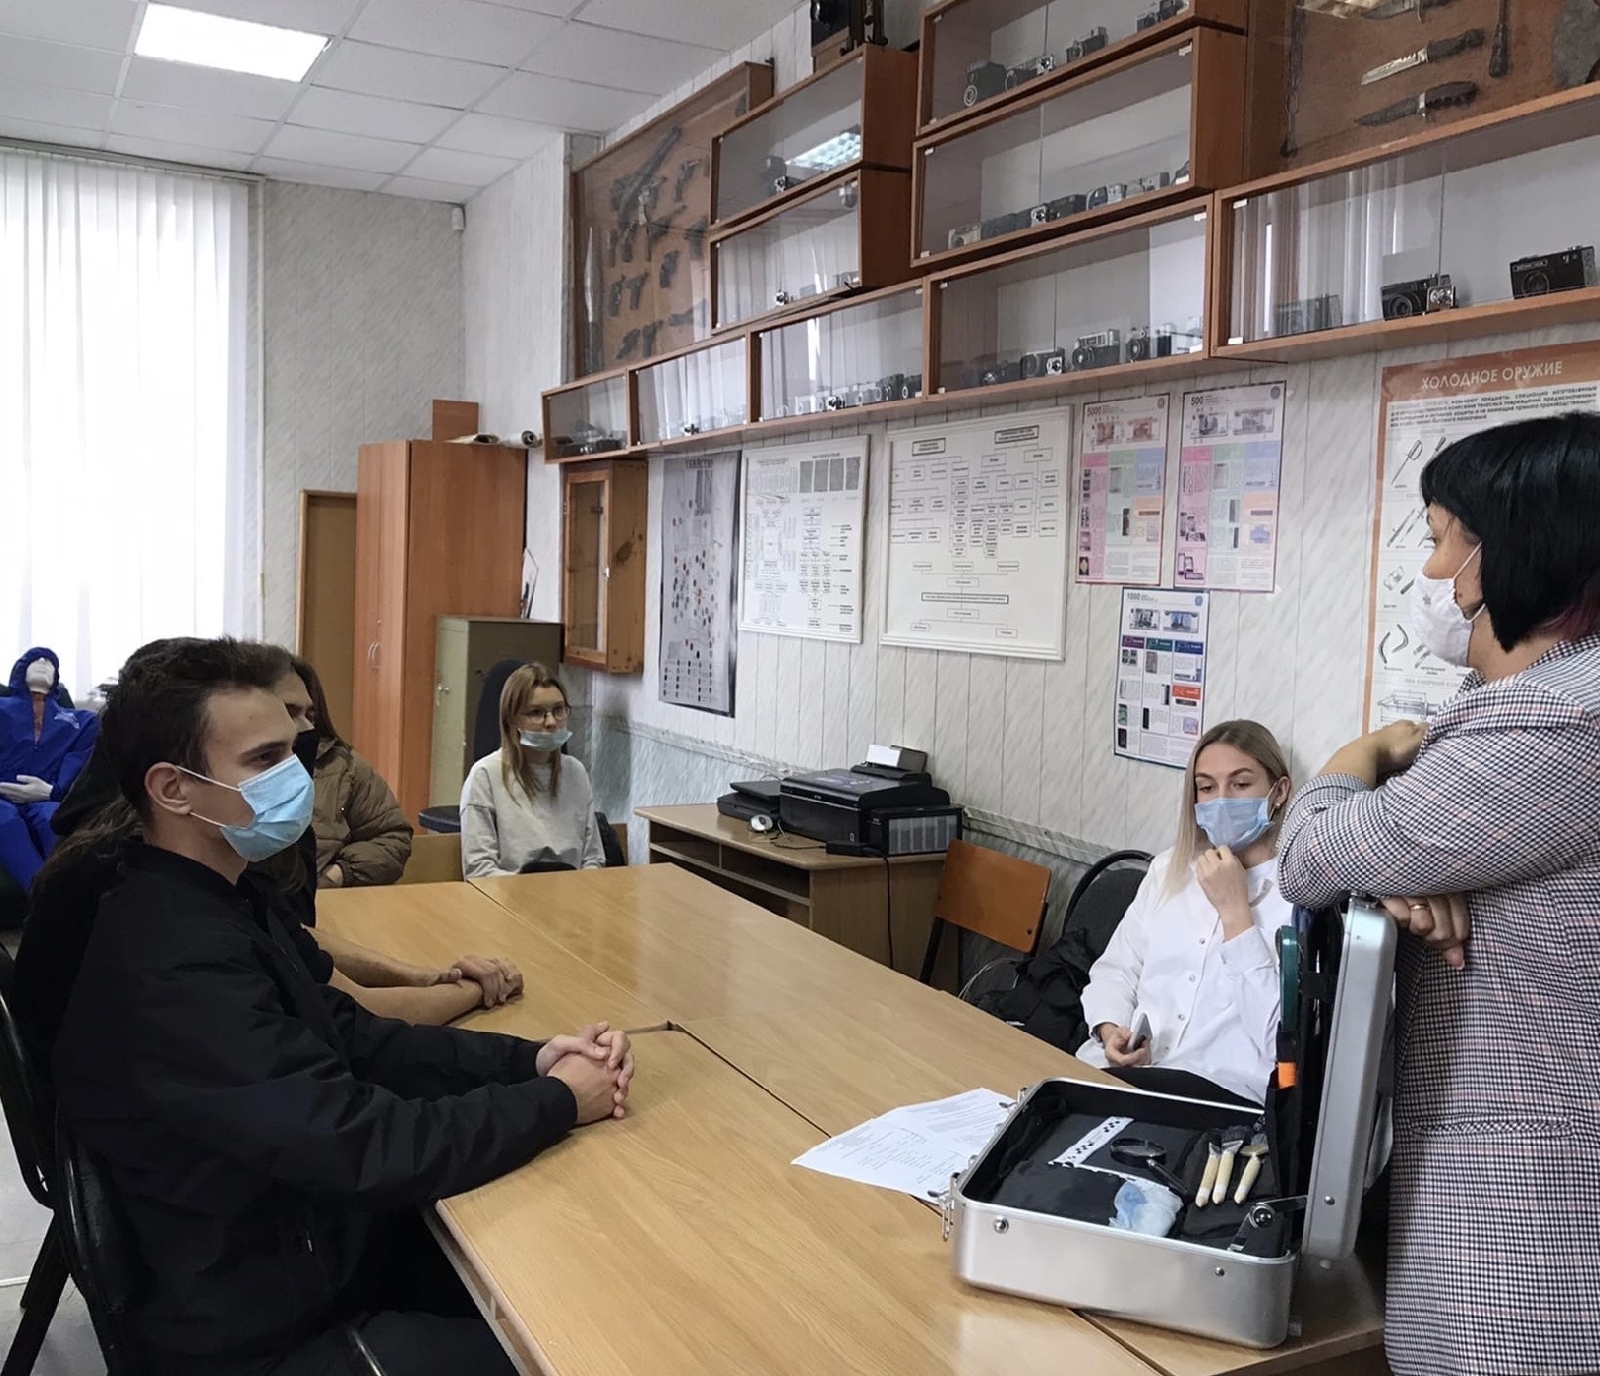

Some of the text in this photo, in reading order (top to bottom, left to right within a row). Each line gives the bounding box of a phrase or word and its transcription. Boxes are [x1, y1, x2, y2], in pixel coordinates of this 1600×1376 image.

[1421, 361, 1563, 390] ХОЛОДНОЕ ОРУЖИЕ
[1191, 396, 1203, 406] 500
[1087, 406, 1101, 416] 5000
